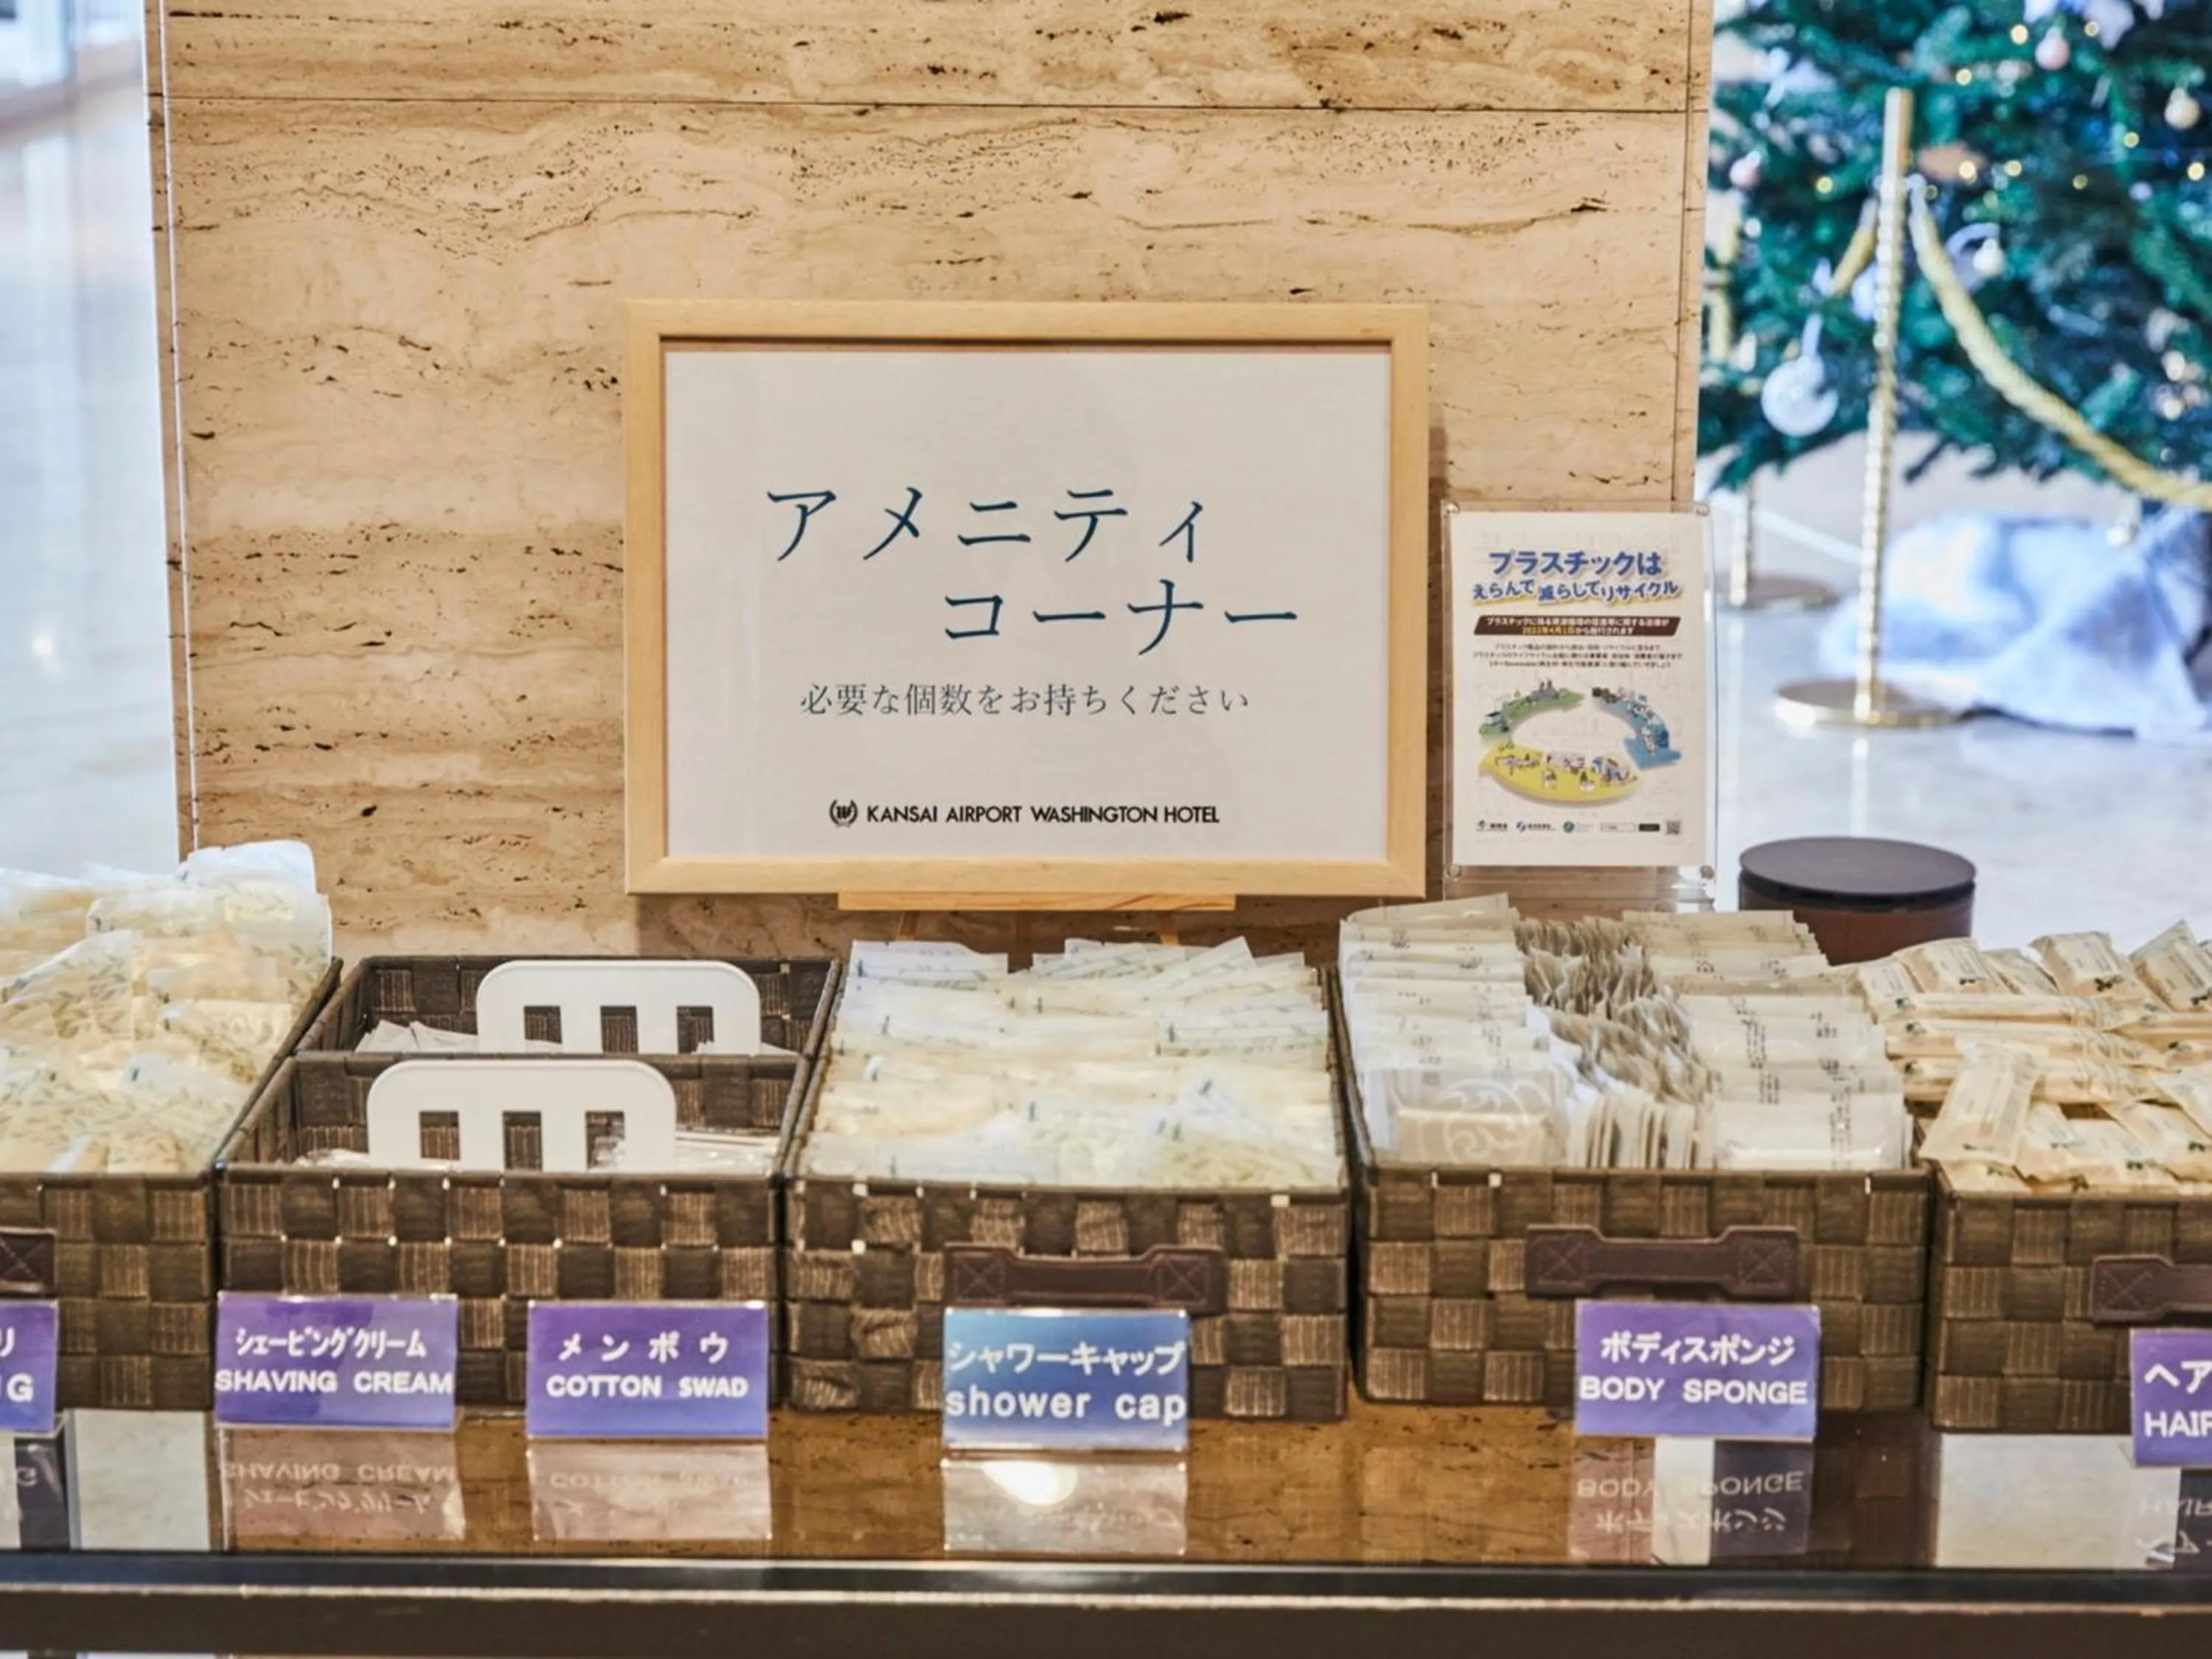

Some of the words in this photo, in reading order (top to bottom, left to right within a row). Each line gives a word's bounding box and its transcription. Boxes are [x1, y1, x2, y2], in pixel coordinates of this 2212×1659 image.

[766, 486, 1203, 562] アメニティ
[1489, 549, 1663, 575] プラスチックは
[945, 579, 1298, 655] コーナー
[800, 683, 1249, 716] 必要な個数をお持ちください
[866, 806, 938, 823] KANSAI
[946, 806, 1023, 823] AIRPORT
[1030, 806, 1158, 824] WASHINGTON
[1164, 806, 1220, 824] HOTEL
[948, 1340, 1186, 1376] シャワーキャップ
[1601, 1330, 1795, 1365] ボディスポンジ
[215, 1369, 338, 1392] SHAVING
[354, 1371, 453, 1394] CREAM
[546, 1374, 662, 1398] COTTON
[678, 1377, 749, 1398] SWAD
[1579, 1376, 1664, 1401] BODY
[1683, 1378, 1808, 1405] SPONGE
[946, 1384, 1091, 1419] shower
[1115, 1393, 1187, 1427] cap
